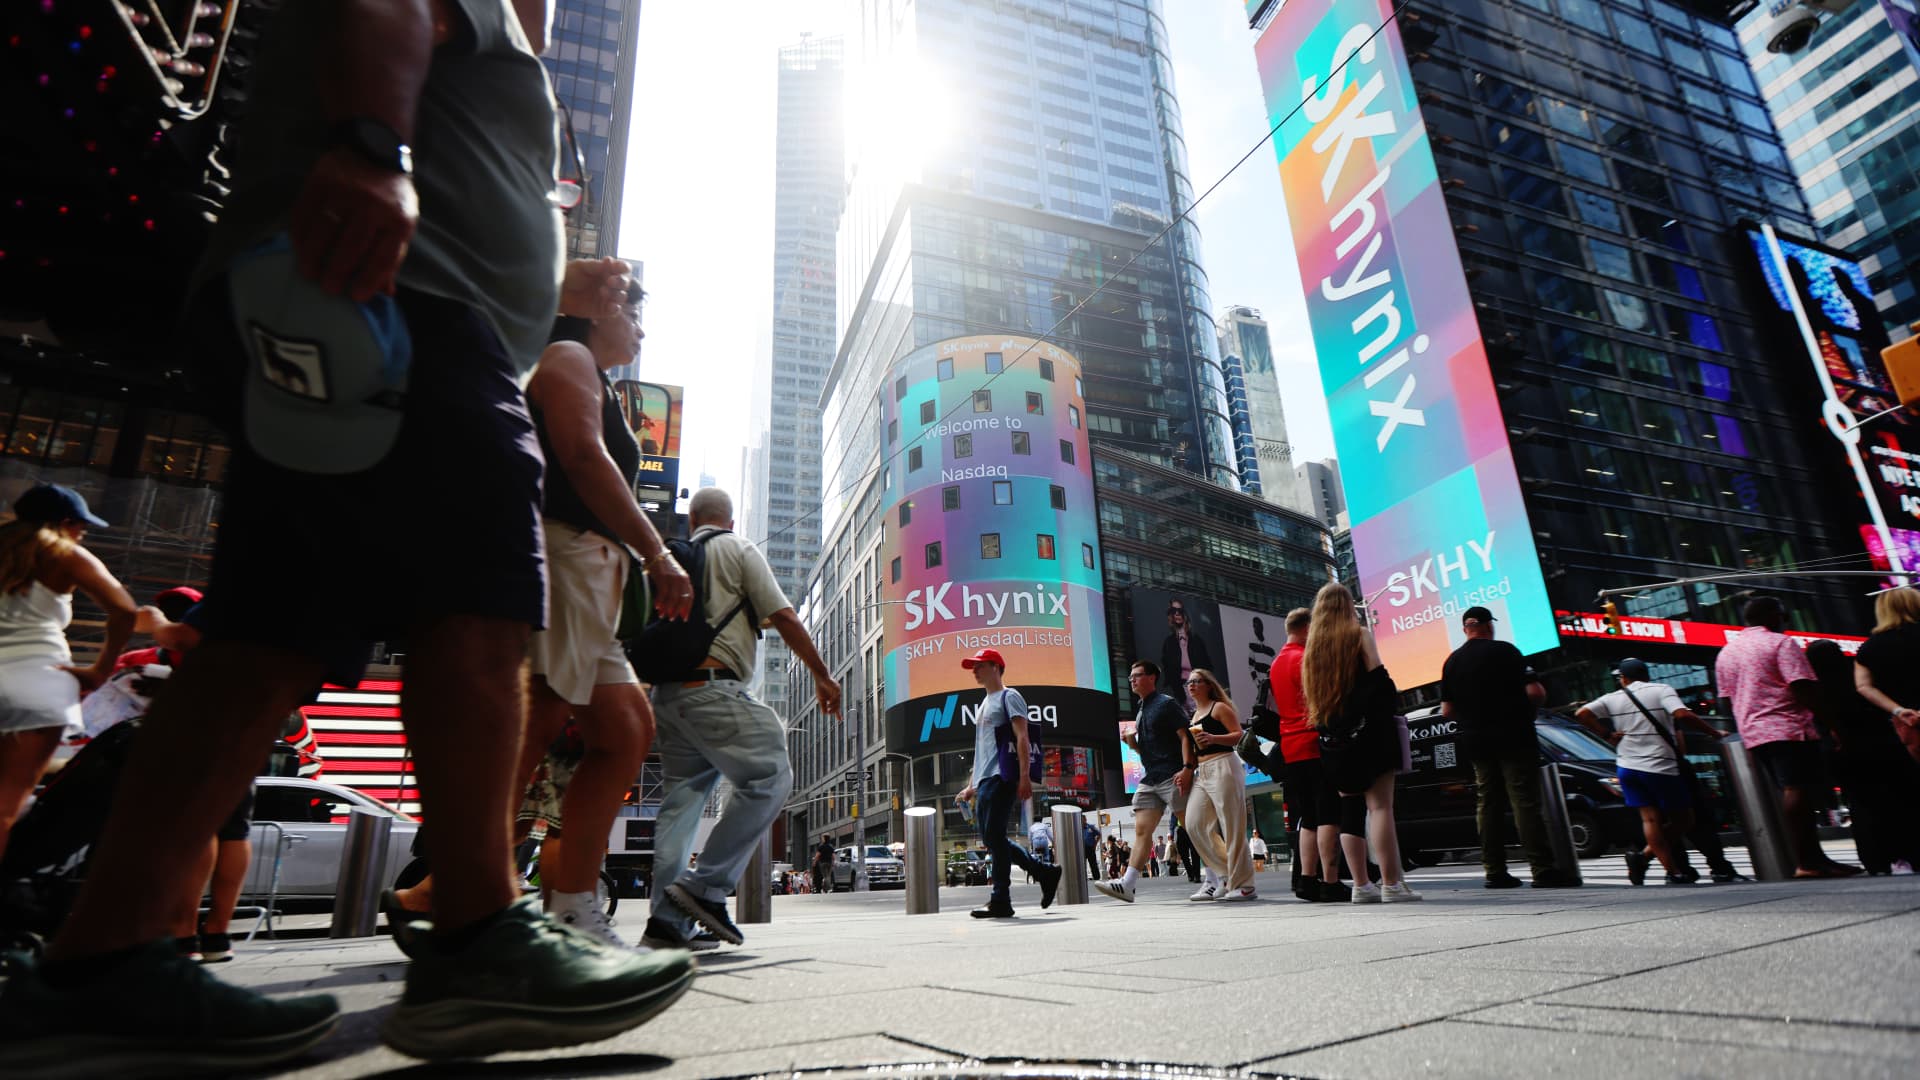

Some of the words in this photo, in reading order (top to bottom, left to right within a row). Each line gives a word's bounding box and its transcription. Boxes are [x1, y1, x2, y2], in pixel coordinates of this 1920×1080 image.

[1303, 23, 1397, 204] SK
[1321, 165, 1430, 454] hynix
[924, 417, 999, 440] Welcome
[1004, 416, 1022, 430] to
[639, 460, 663, 471] RAEL
[941, 464, 1008, 483] Nasdaq
[1387, 530, 1496, 607] SKHY
[904, 581, 956, 631] SK
[962, 583, 1069, 626] hynix
[1392, 576, 1512, 635] NasdaqListed
[905, 637, 945, 662] SKHY
[956, 630, 1072, 650] NasdaqListed
[961, 704, 1058, 728] Naq
[1431, 721, 1457, 737] NYC
